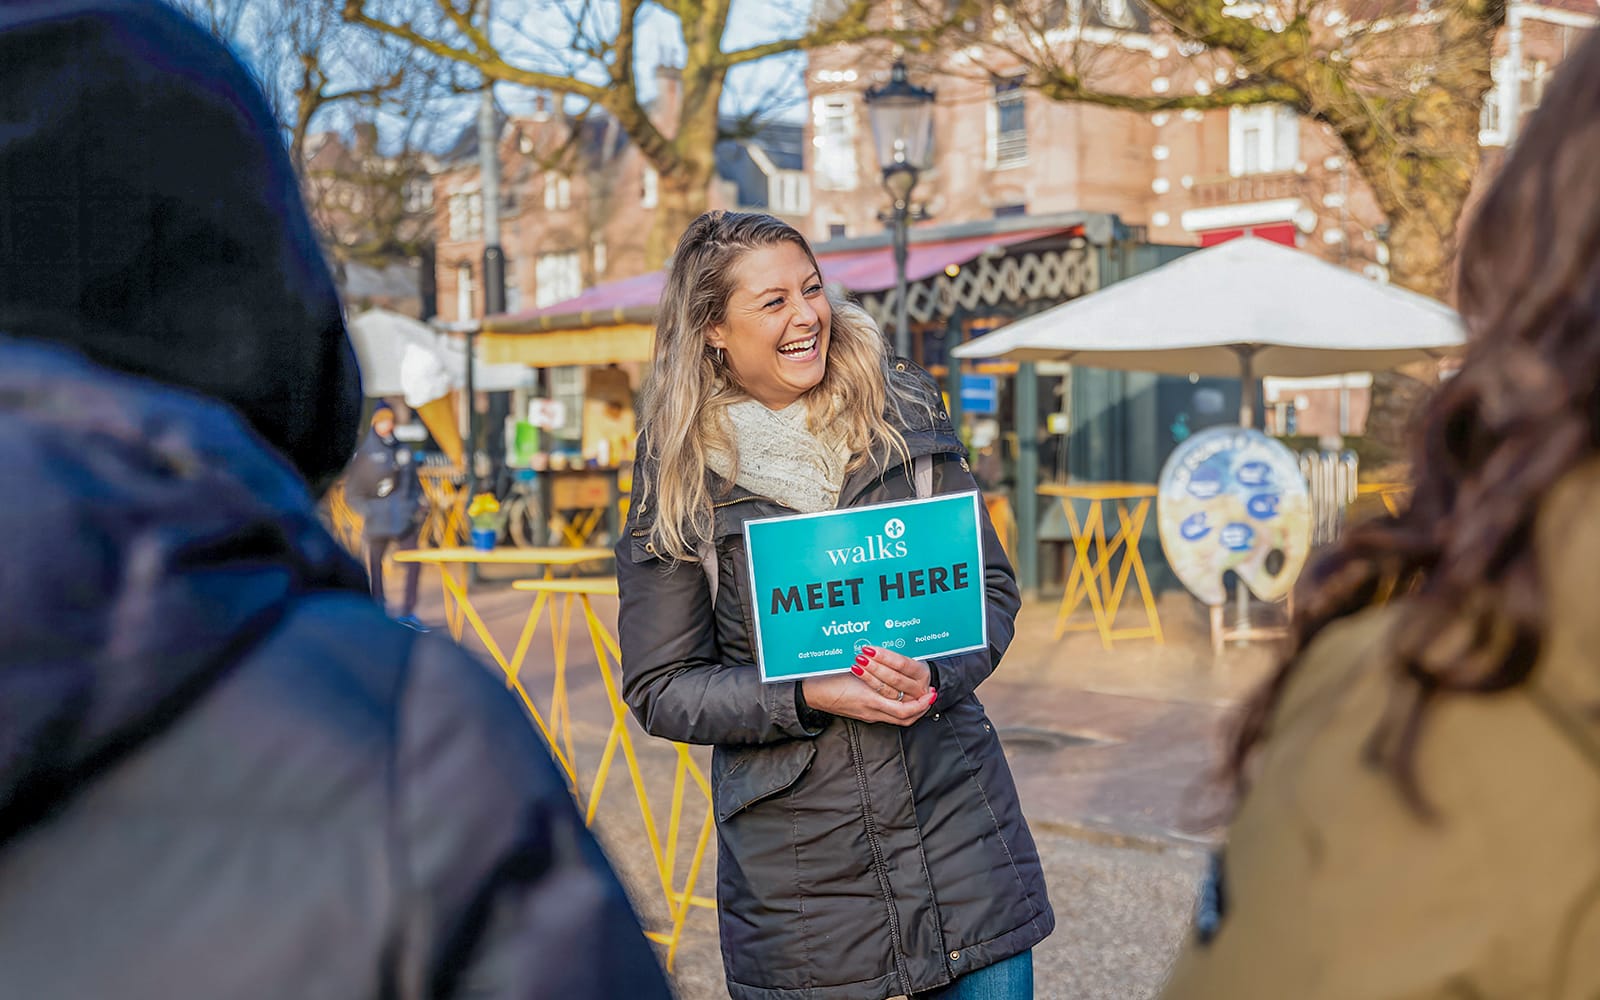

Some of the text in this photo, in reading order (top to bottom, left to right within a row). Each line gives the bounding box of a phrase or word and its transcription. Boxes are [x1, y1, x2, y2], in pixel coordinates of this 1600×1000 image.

[826, 534, 908, 566] walks
[771, 562, 969, 614] MEET HERE
[822, 620, 870, 636] viator
